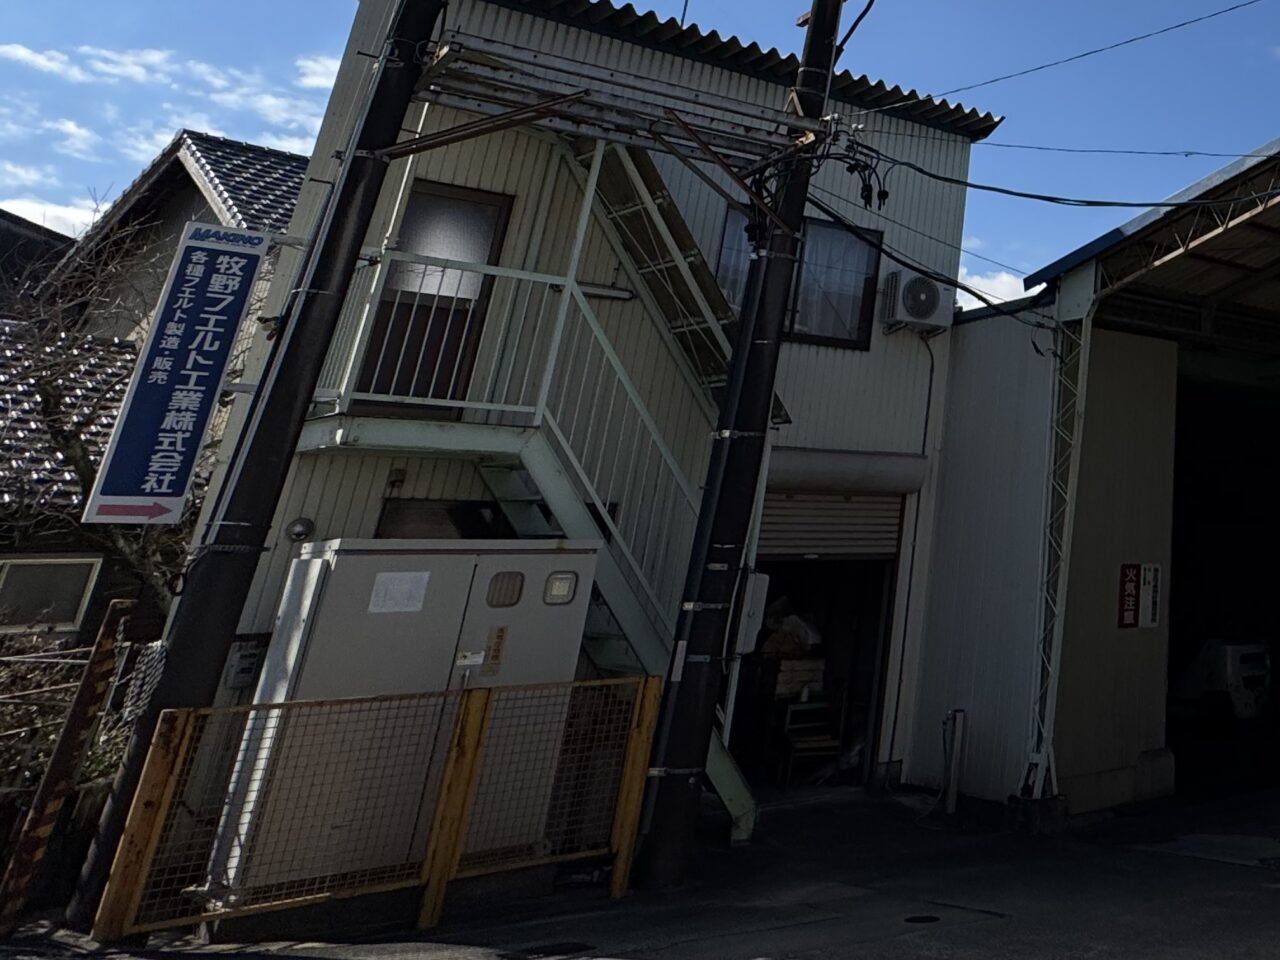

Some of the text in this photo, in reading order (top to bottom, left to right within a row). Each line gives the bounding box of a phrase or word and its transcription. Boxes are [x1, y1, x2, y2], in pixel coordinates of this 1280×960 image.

[188, 227, 264, 246] MAKINO
[140, 254, 248, 494] 牧野フエルト工業株式会社
[147, 250, 208, 385] 各種フエルト製造・販売
